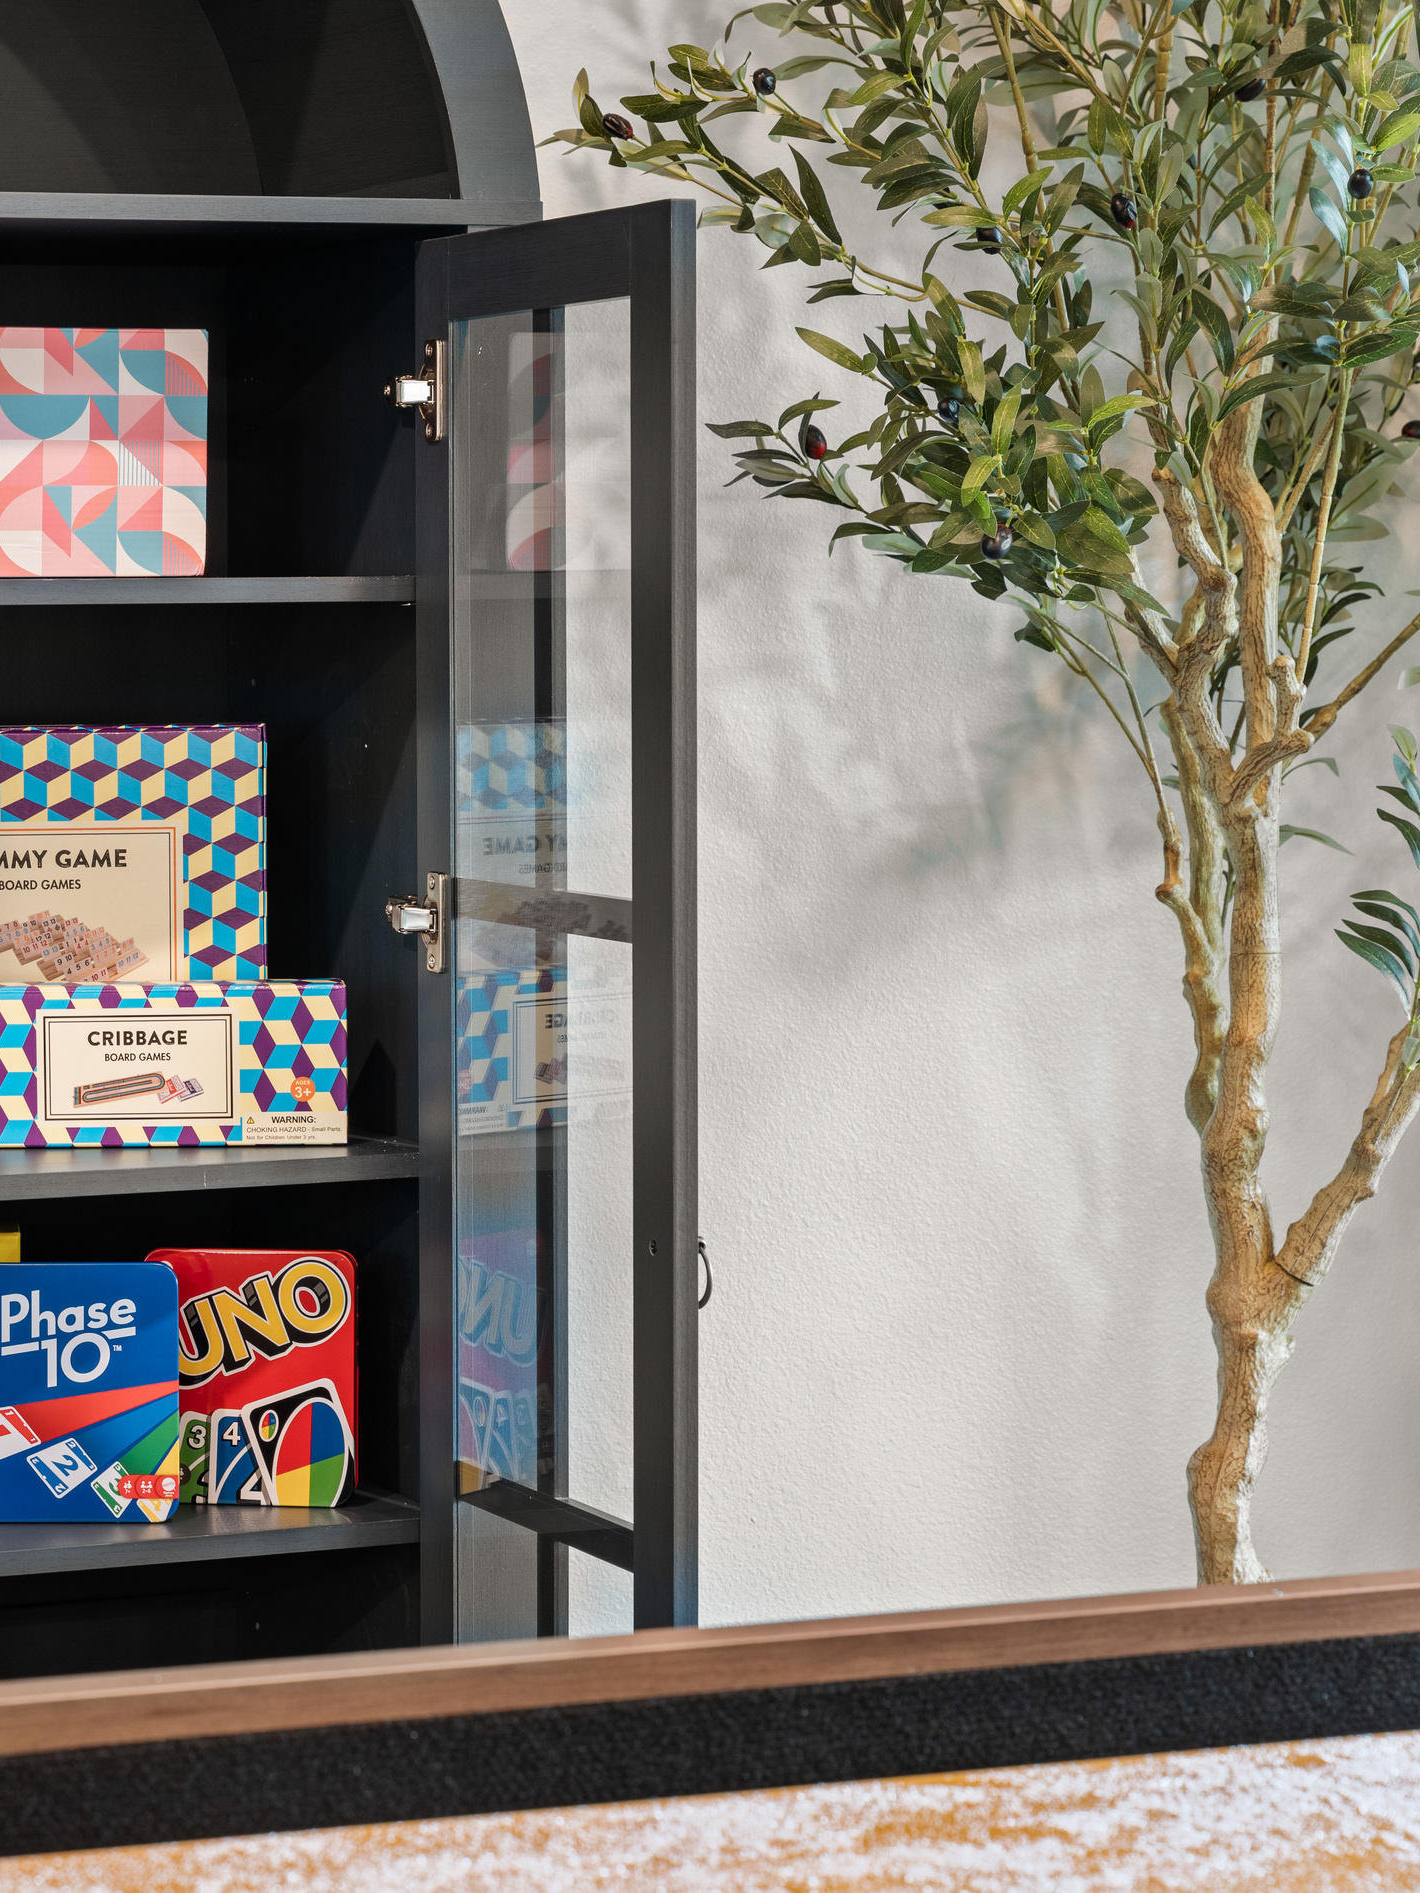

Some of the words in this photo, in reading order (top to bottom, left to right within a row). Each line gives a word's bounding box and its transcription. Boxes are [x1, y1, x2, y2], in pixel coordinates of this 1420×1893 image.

[55, 848, 128, 868] GAME
[41, 879, 81, 890] GAMES
[88, 1030, 188, 1046] CRIBBAGE
[104, 1053, 136, 1062] BOARD
[139, 1052, 172, 1062] GAMES
[294, 1086, 312, 1098] 3+
[271, 1116, 316, 1124] WARNING:
[1, 1290, 136, 1343] Phase
[179, 1256, 351, 1389] UNO
[41, 1332, 110, 1388] 10
[113, 1344, 122, 1352] TM
[187, 1425, 207, 1450] 3
[222, 1421, 241, 1446] 4
[50, 1454, 79, 1478] 2
[54, 1482, 66, 1493] 2
